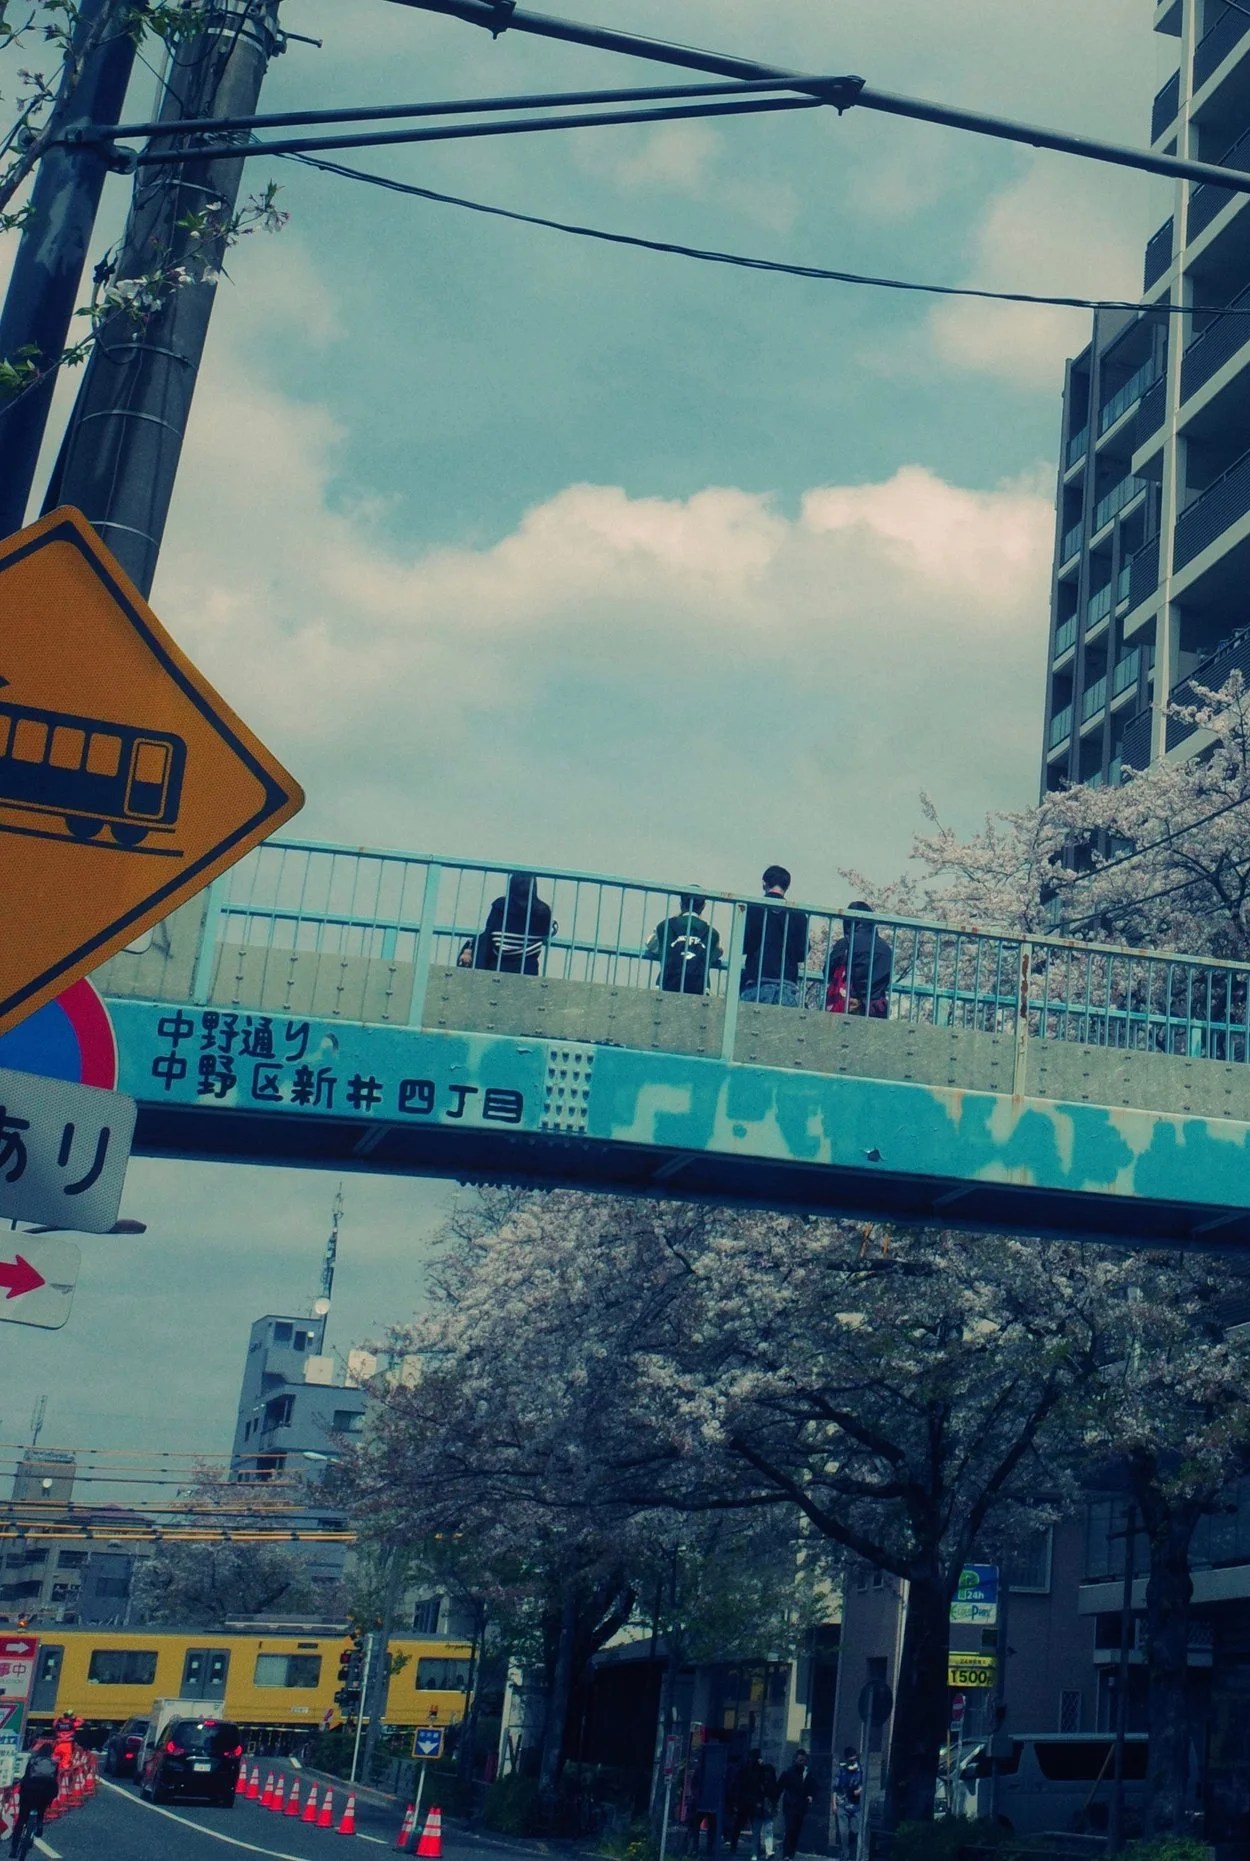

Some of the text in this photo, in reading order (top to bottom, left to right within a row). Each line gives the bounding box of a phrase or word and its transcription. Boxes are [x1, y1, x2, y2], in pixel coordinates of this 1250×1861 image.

[157, 1009, 310, 1061] 中野通り
[152, 1052, 524, 1124] 中野区新井四丁目
[967, 1590, 985, 1600] 24h
